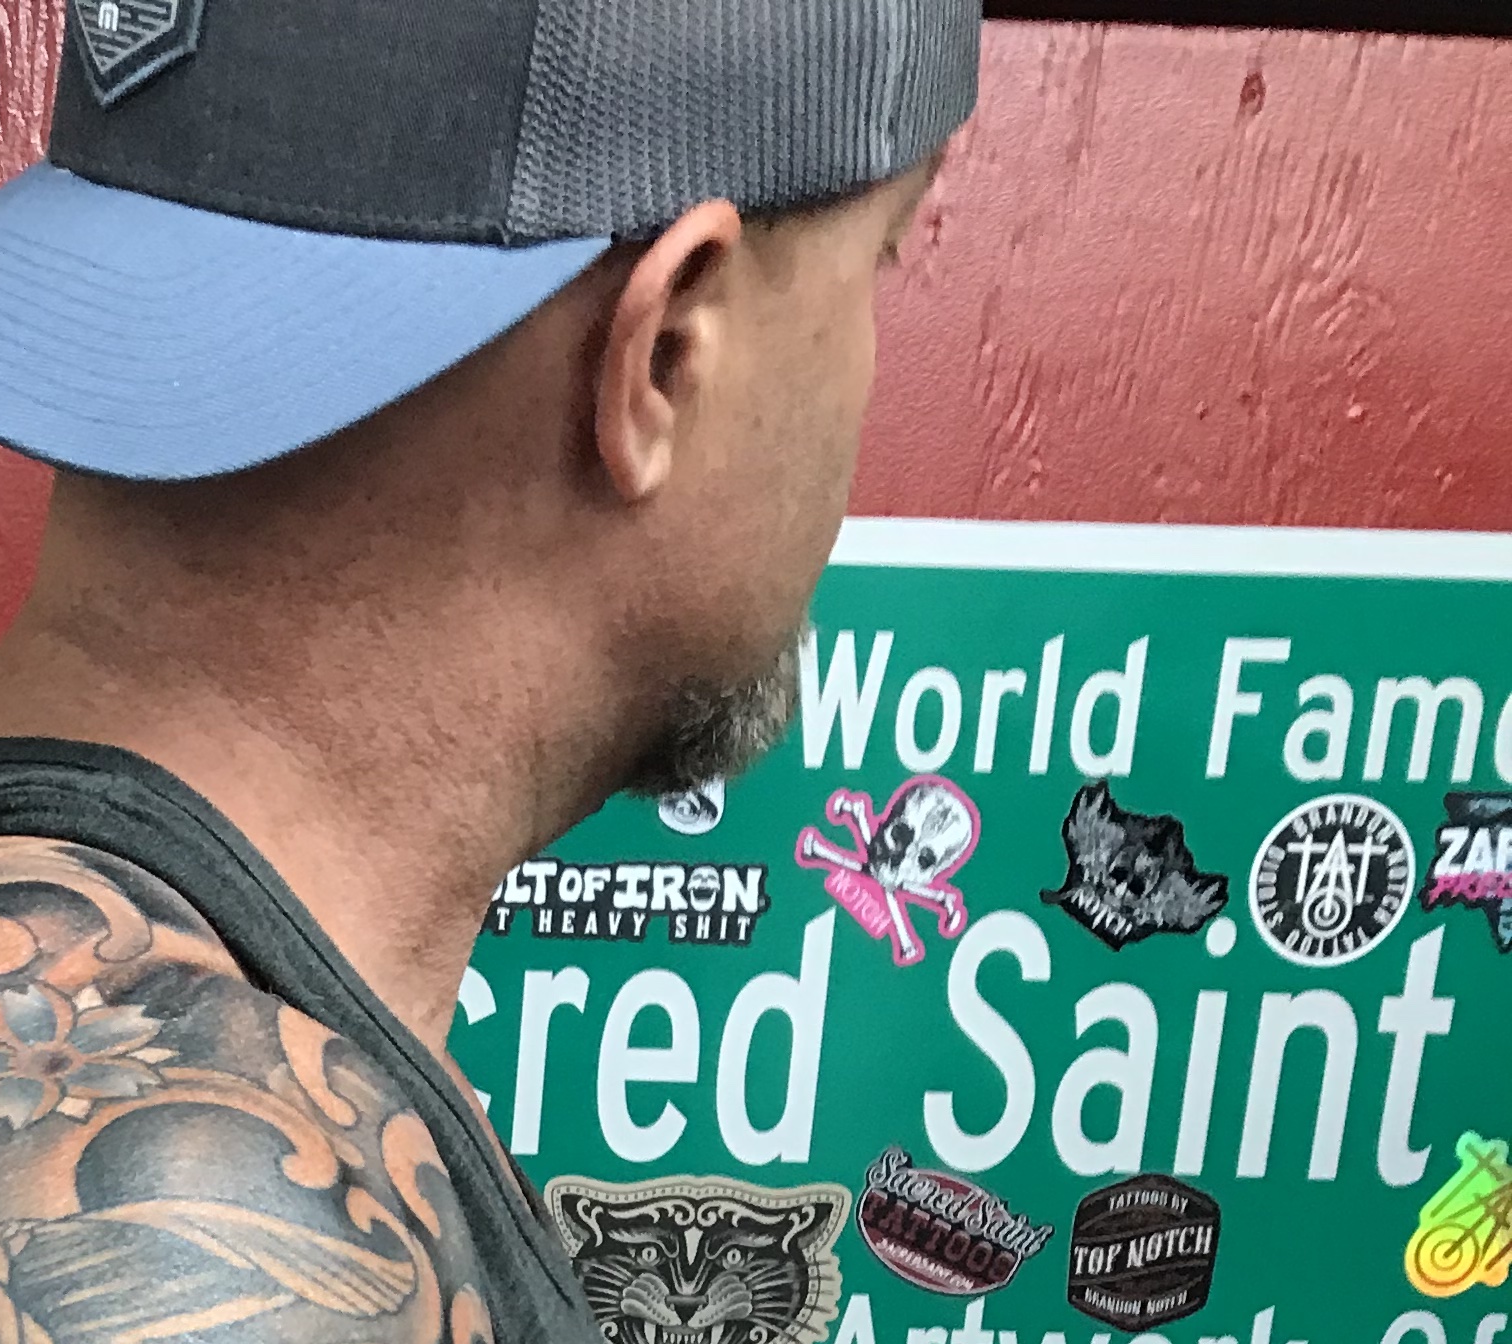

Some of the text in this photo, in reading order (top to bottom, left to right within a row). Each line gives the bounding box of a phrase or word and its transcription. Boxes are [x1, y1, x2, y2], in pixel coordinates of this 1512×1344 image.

[797, 630, 1149, 776] World
[492, 860, 763, 914] LT OF IRON
[830, 869, 892, 934] NOTCH
[538, 908, 646, 937] HEAVY
[675, 913, 751, 941] SHIT
[922, 909, 1456, 1188] Saint
[868, 1147, 1054, 1258] Sacred Saint
[1074, 1225, 1214, 1275] TOP NOTCH
